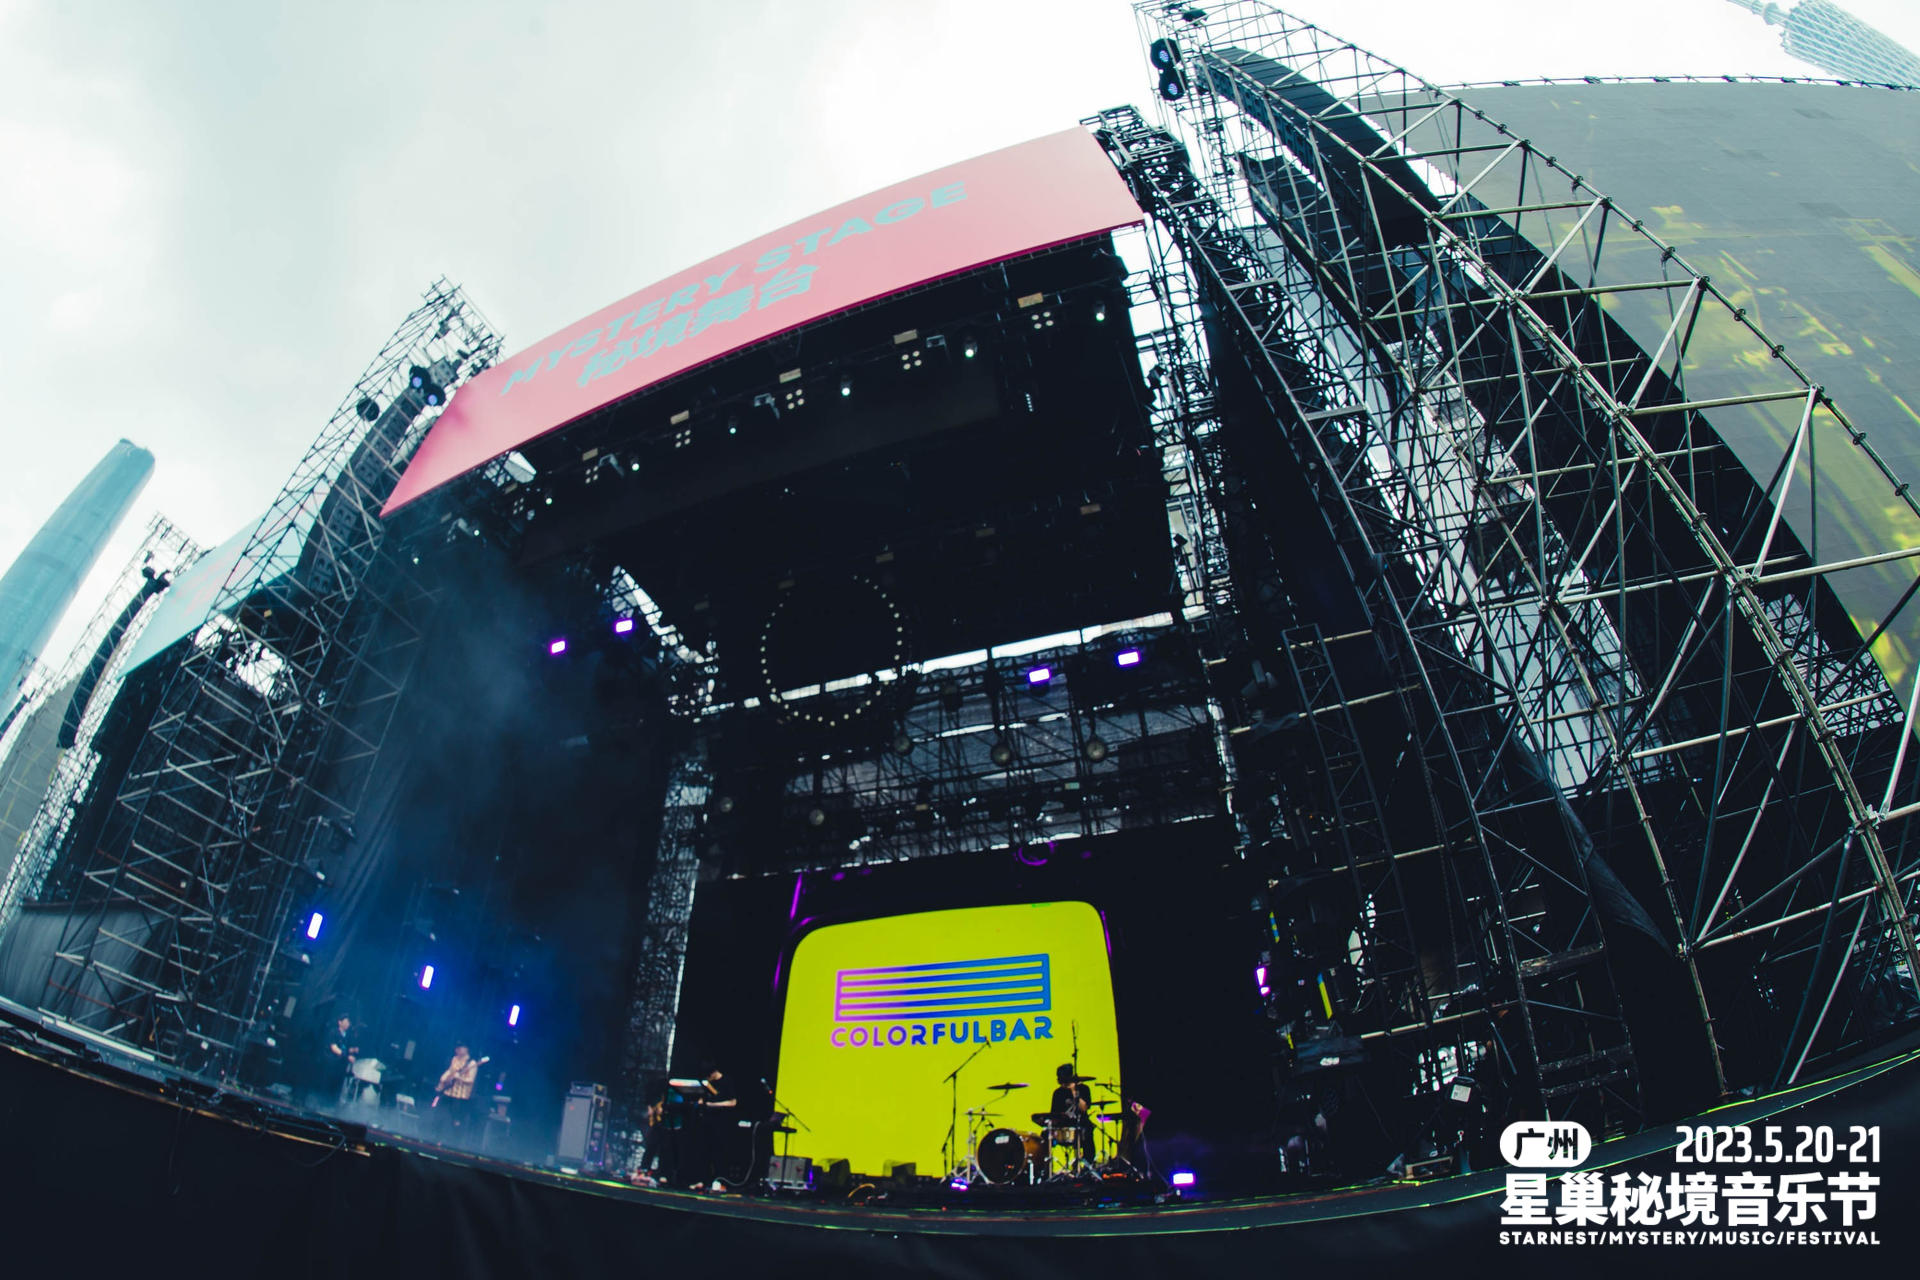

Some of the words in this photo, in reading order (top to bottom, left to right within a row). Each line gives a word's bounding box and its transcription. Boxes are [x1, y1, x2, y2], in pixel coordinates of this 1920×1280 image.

[500, 264, 742, 395] MYSTERY
[754, 179, 969, 274] STAGE
[831, 1017, 1053, 1047] COLORFULBAR
